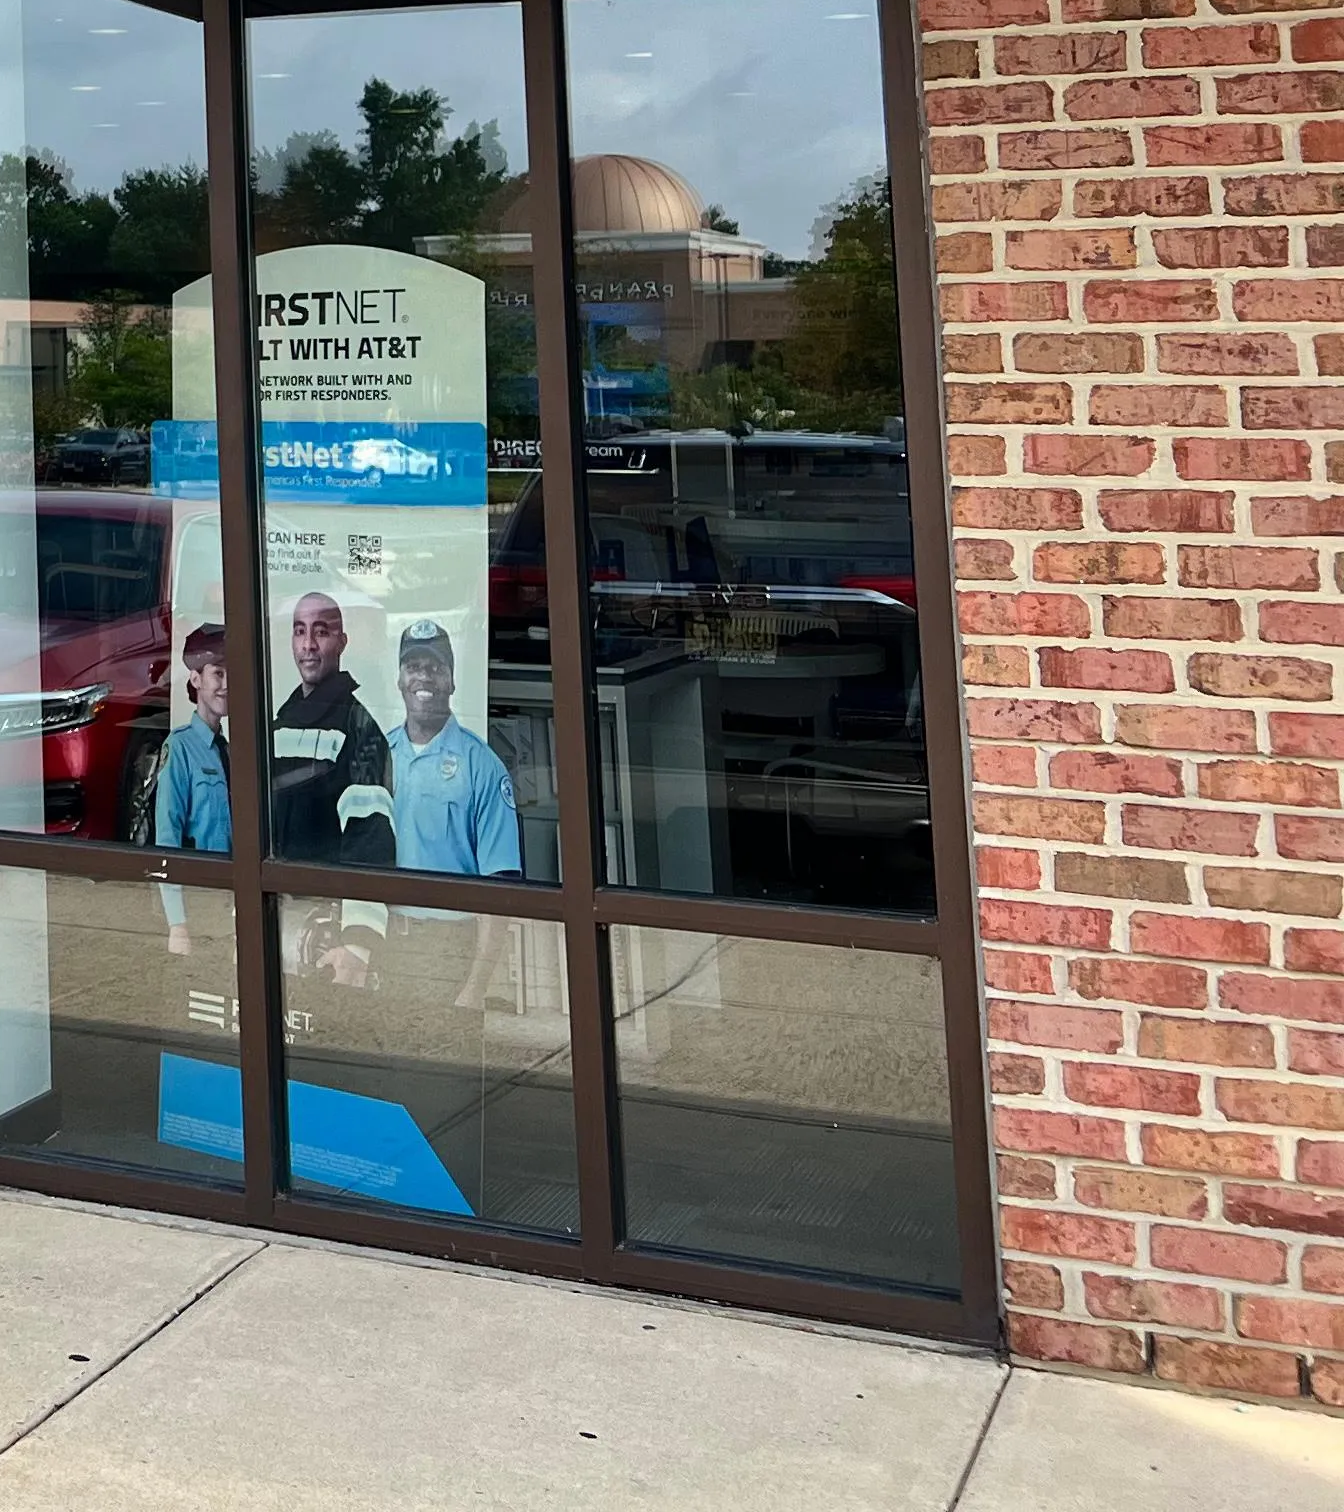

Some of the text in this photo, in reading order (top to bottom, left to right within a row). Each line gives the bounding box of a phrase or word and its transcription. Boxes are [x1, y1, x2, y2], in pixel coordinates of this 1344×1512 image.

[290, 338, 350, 361] WITH
[357, 336, 422, 360] AT&T
[317, 375, 348, 386] BUILT
[352, 374, 383, 386] WITH
[387, 374, 413, 385] AND
[259, 390, 392, 401] OR FIRST RESPONDERS.
[268, 532, 326, 545] CAN HERE
[267, 561, 289, 571] ou're
